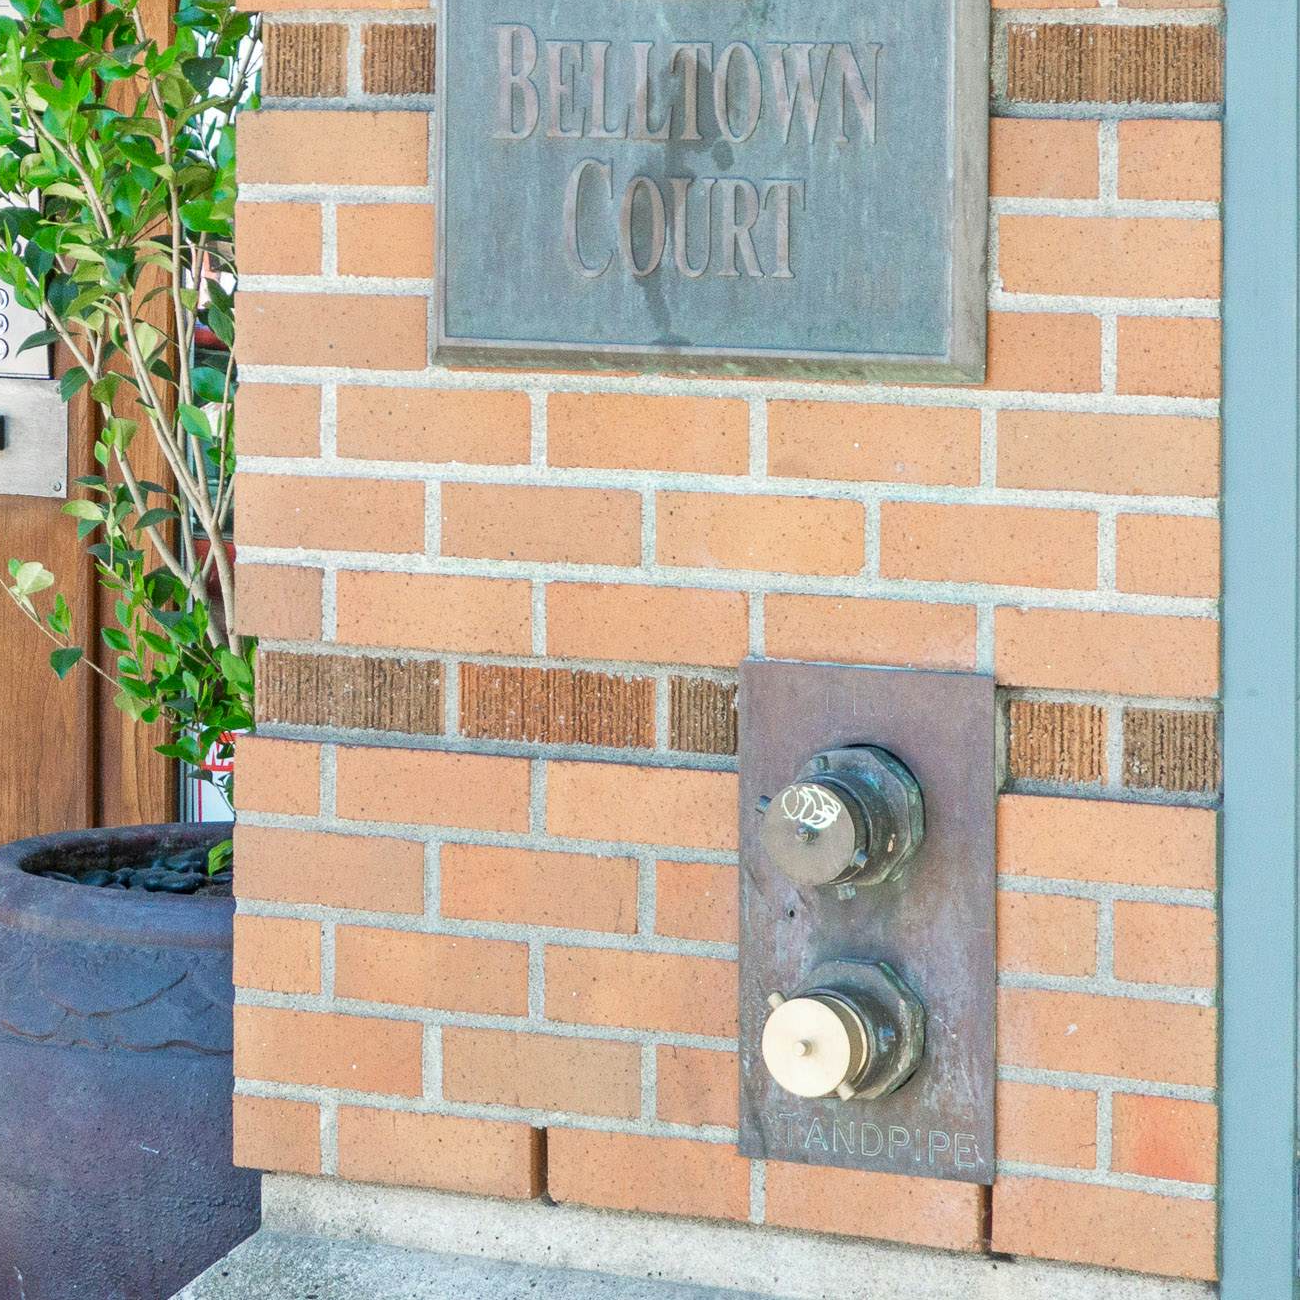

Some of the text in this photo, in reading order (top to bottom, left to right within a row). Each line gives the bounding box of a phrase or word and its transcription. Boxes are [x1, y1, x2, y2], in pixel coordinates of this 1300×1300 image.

[492, 22, 884, 146] BELLTOWN
[564, 157, 808, 281] COURT
[761, 1111, 977, 1169] TANDPIPE
